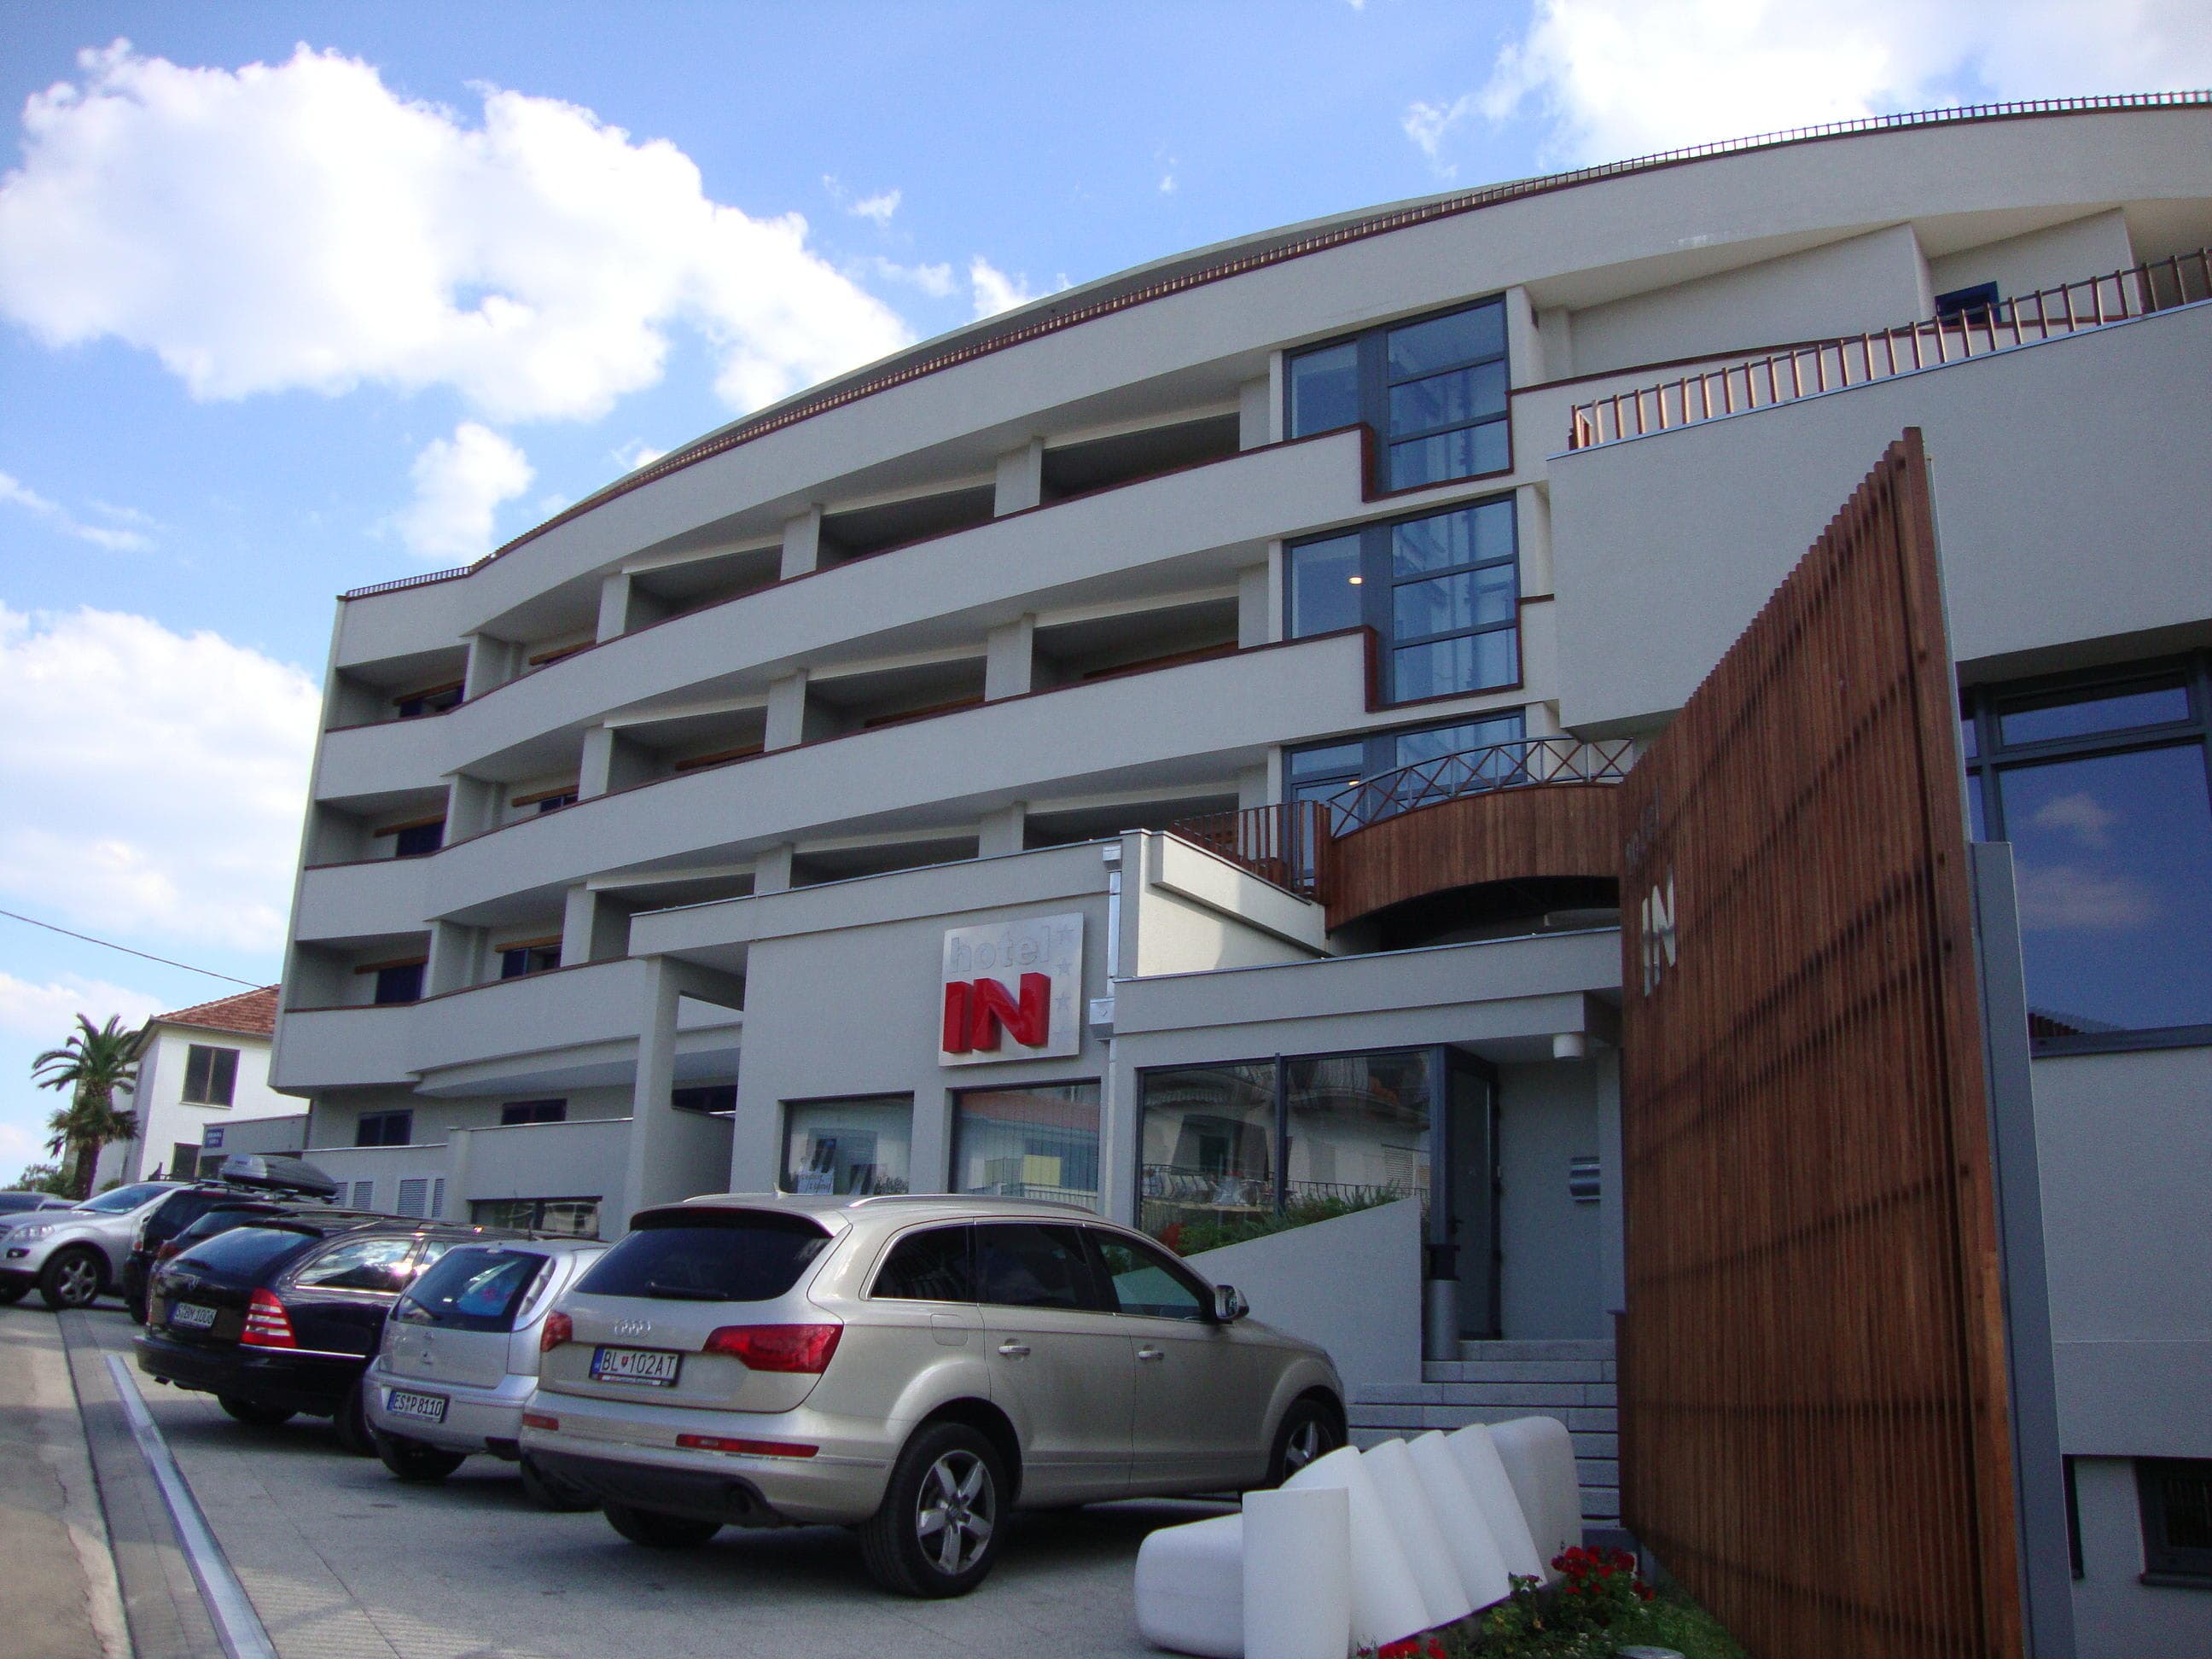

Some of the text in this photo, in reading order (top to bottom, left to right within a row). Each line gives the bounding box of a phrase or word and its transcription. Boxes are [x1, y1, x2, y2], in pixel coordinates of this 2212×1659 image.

[946, 925, 1051, 973] hotel
[1642, 864, 1676, 997] IN
[943, 972, 1051, 1054] IN
[602, 1351, 675, 1376] BL 102AT
